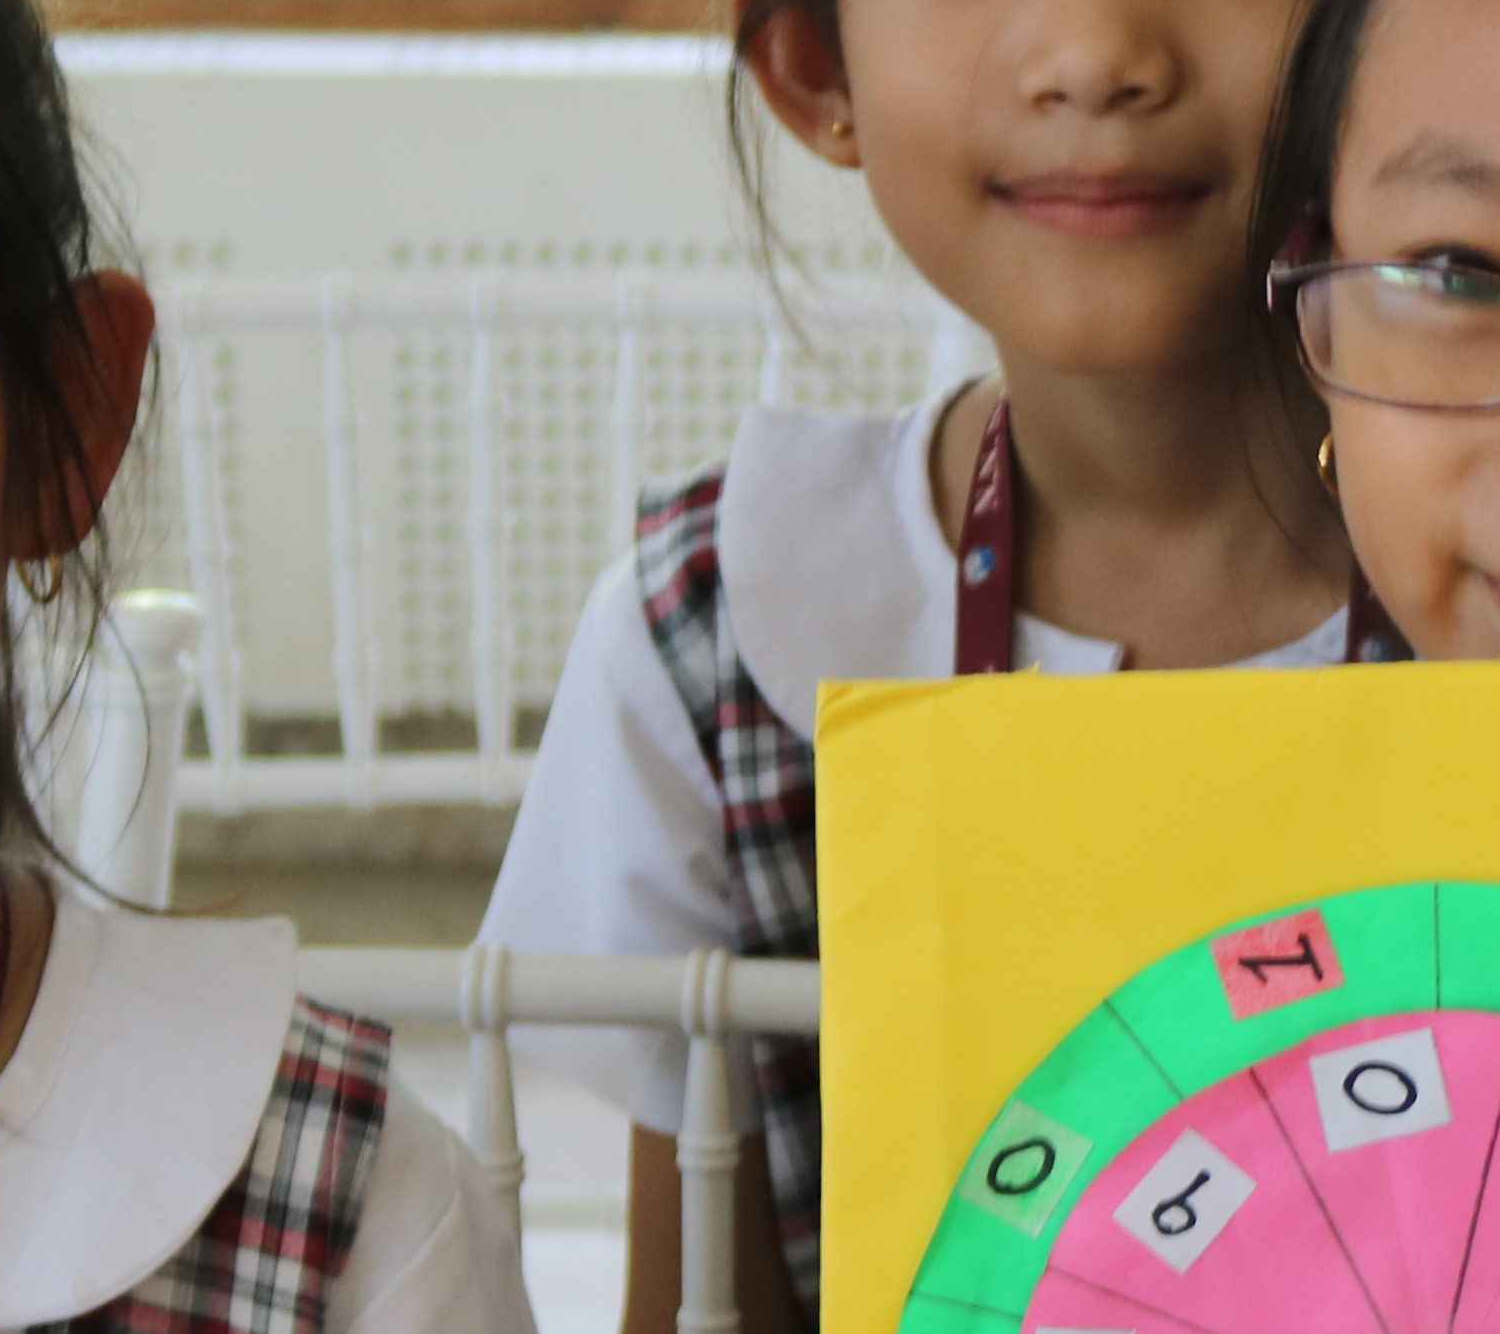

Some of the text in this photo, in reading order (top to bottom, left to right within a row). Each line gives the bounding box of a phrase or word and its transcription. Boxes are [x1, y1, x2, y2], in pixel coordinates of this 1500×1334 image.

[1239, 932, 1326, 986] 1
[1342, 1062, 1419, 1116] 0
[985, 1138, 1057, 1197] 0
[1150, 1170, 1211, 1237] 9
